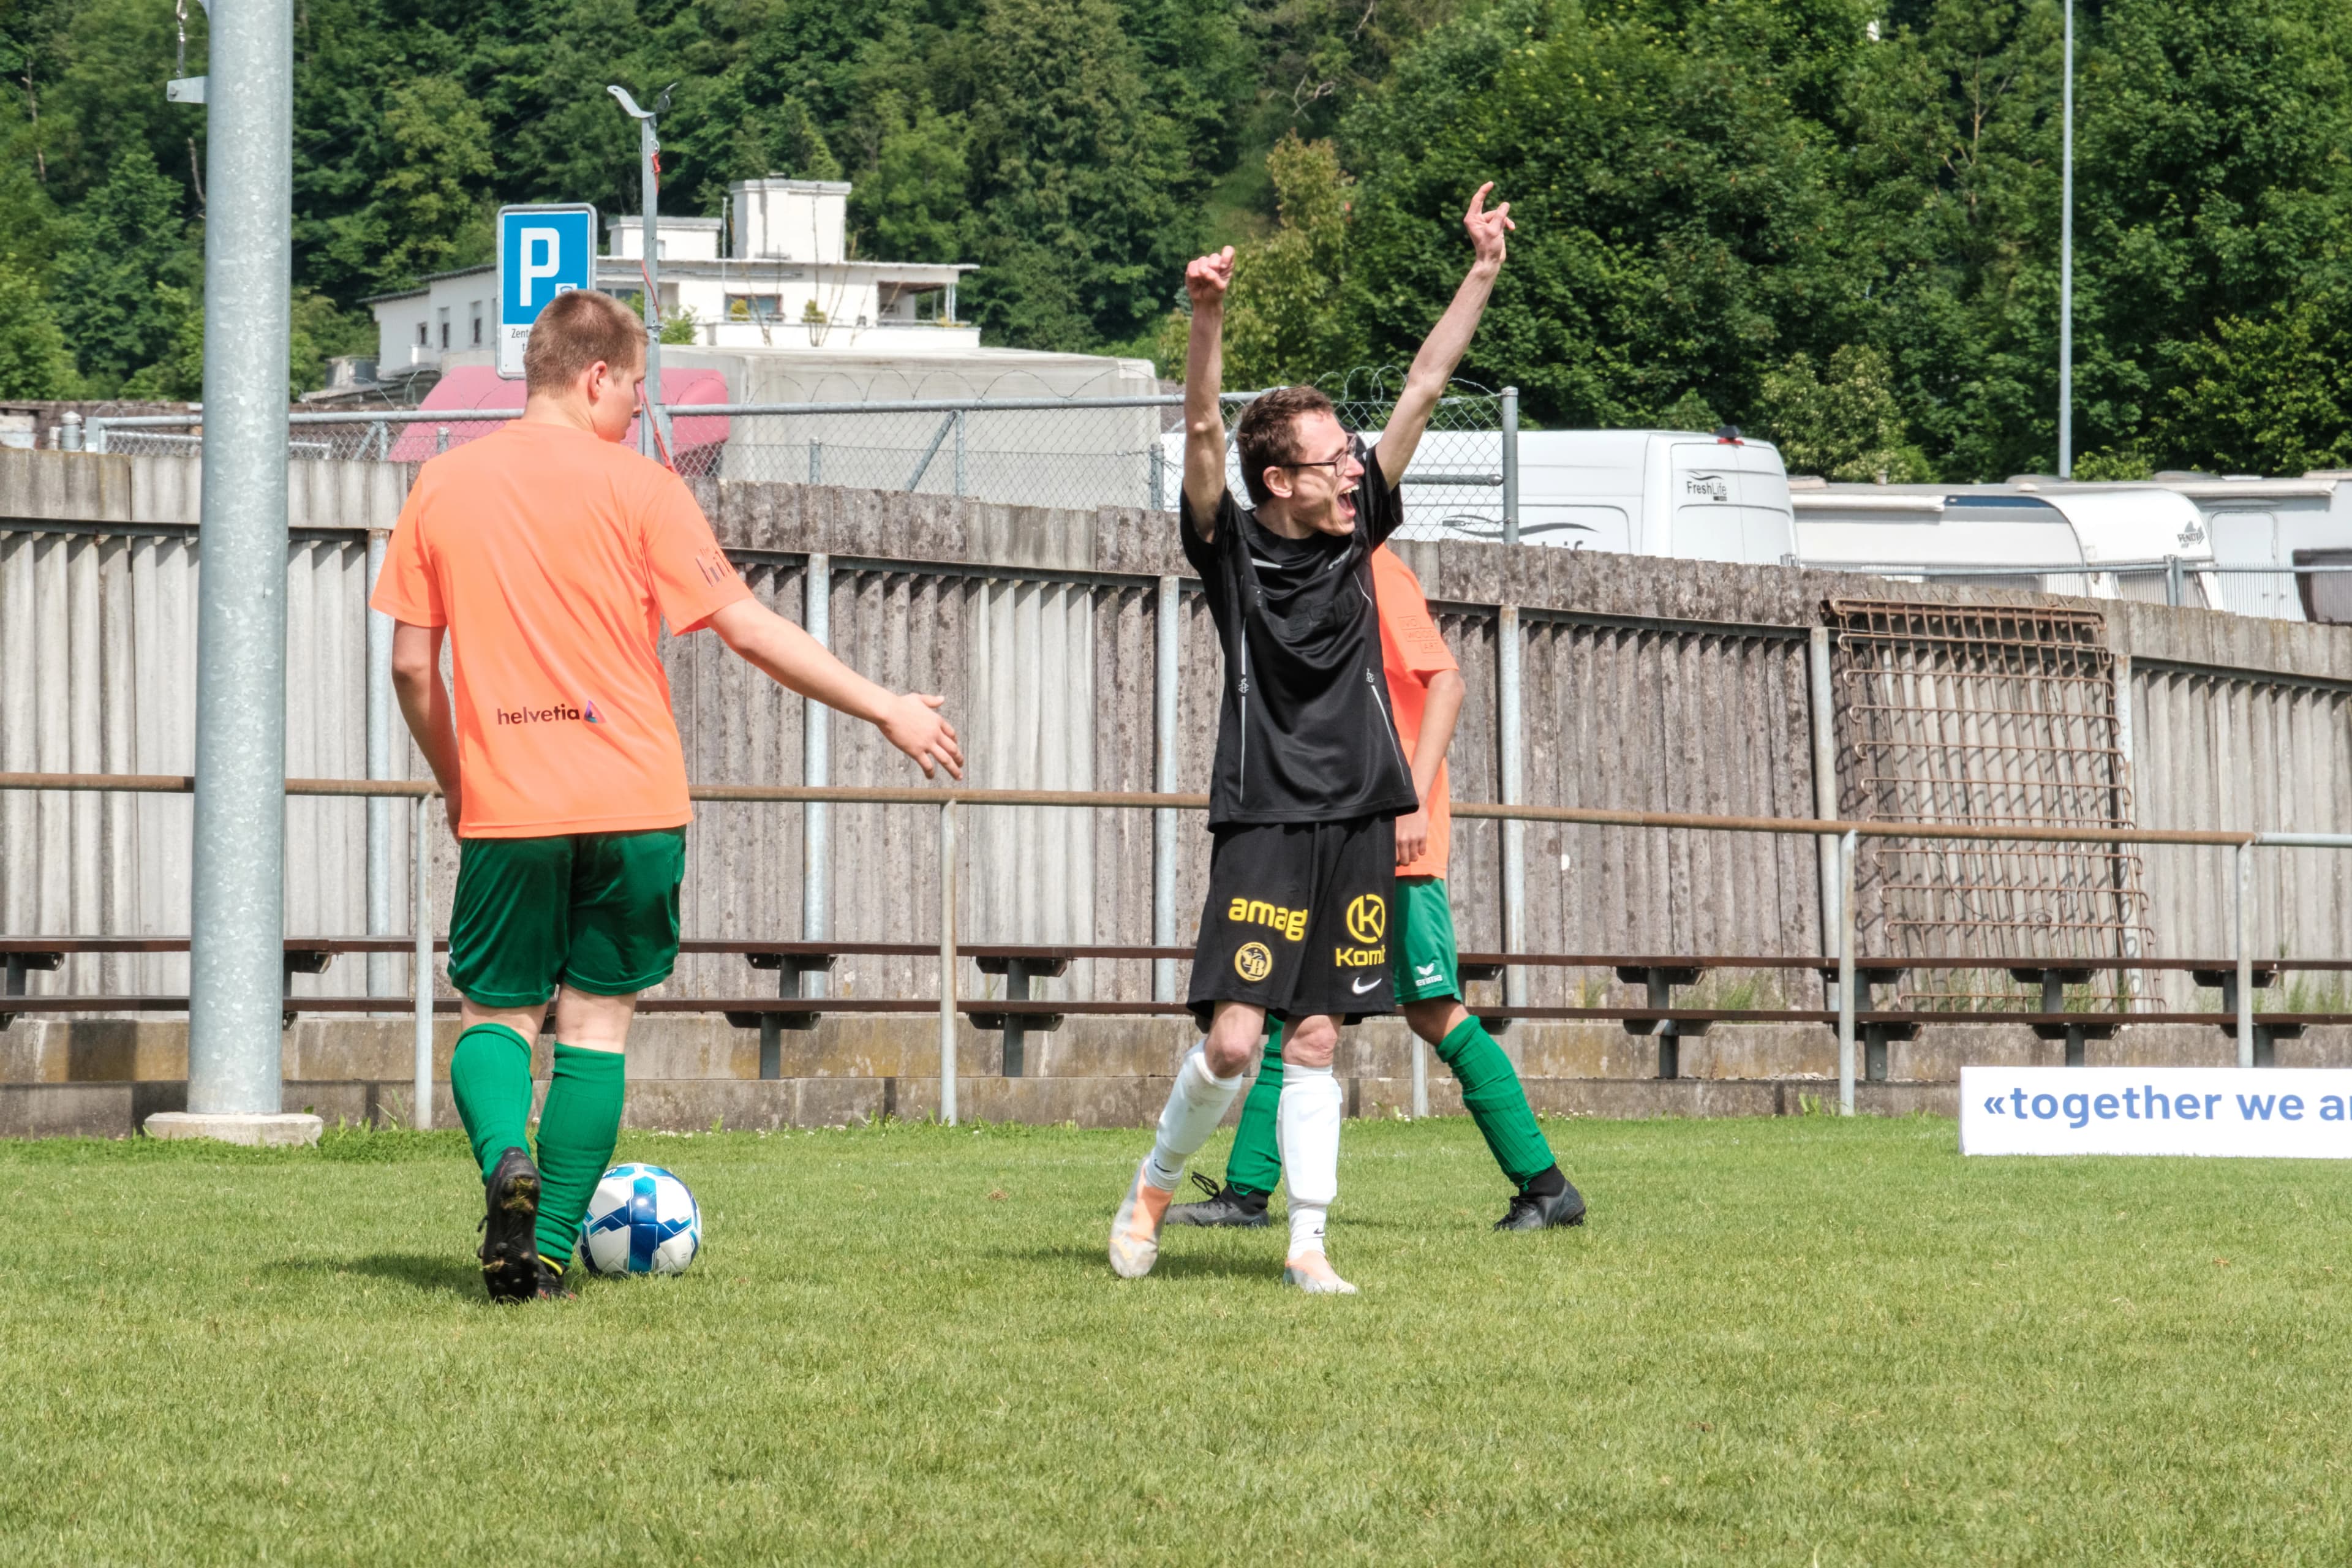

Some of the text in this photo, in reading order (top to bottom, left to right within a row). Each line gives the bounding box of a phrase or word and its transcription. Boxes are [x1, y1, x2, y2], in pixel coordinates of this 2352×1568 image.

[520, 227, 560, 306] P
[511, 328, 529, 338] Zent
[1687, 481, 1727, 496] FreshLife
[497, 704, 580, 725] helvetia
[1229, 898, 1308, 941] amag
[1984, 1085, 2352, 1129] «together we a
